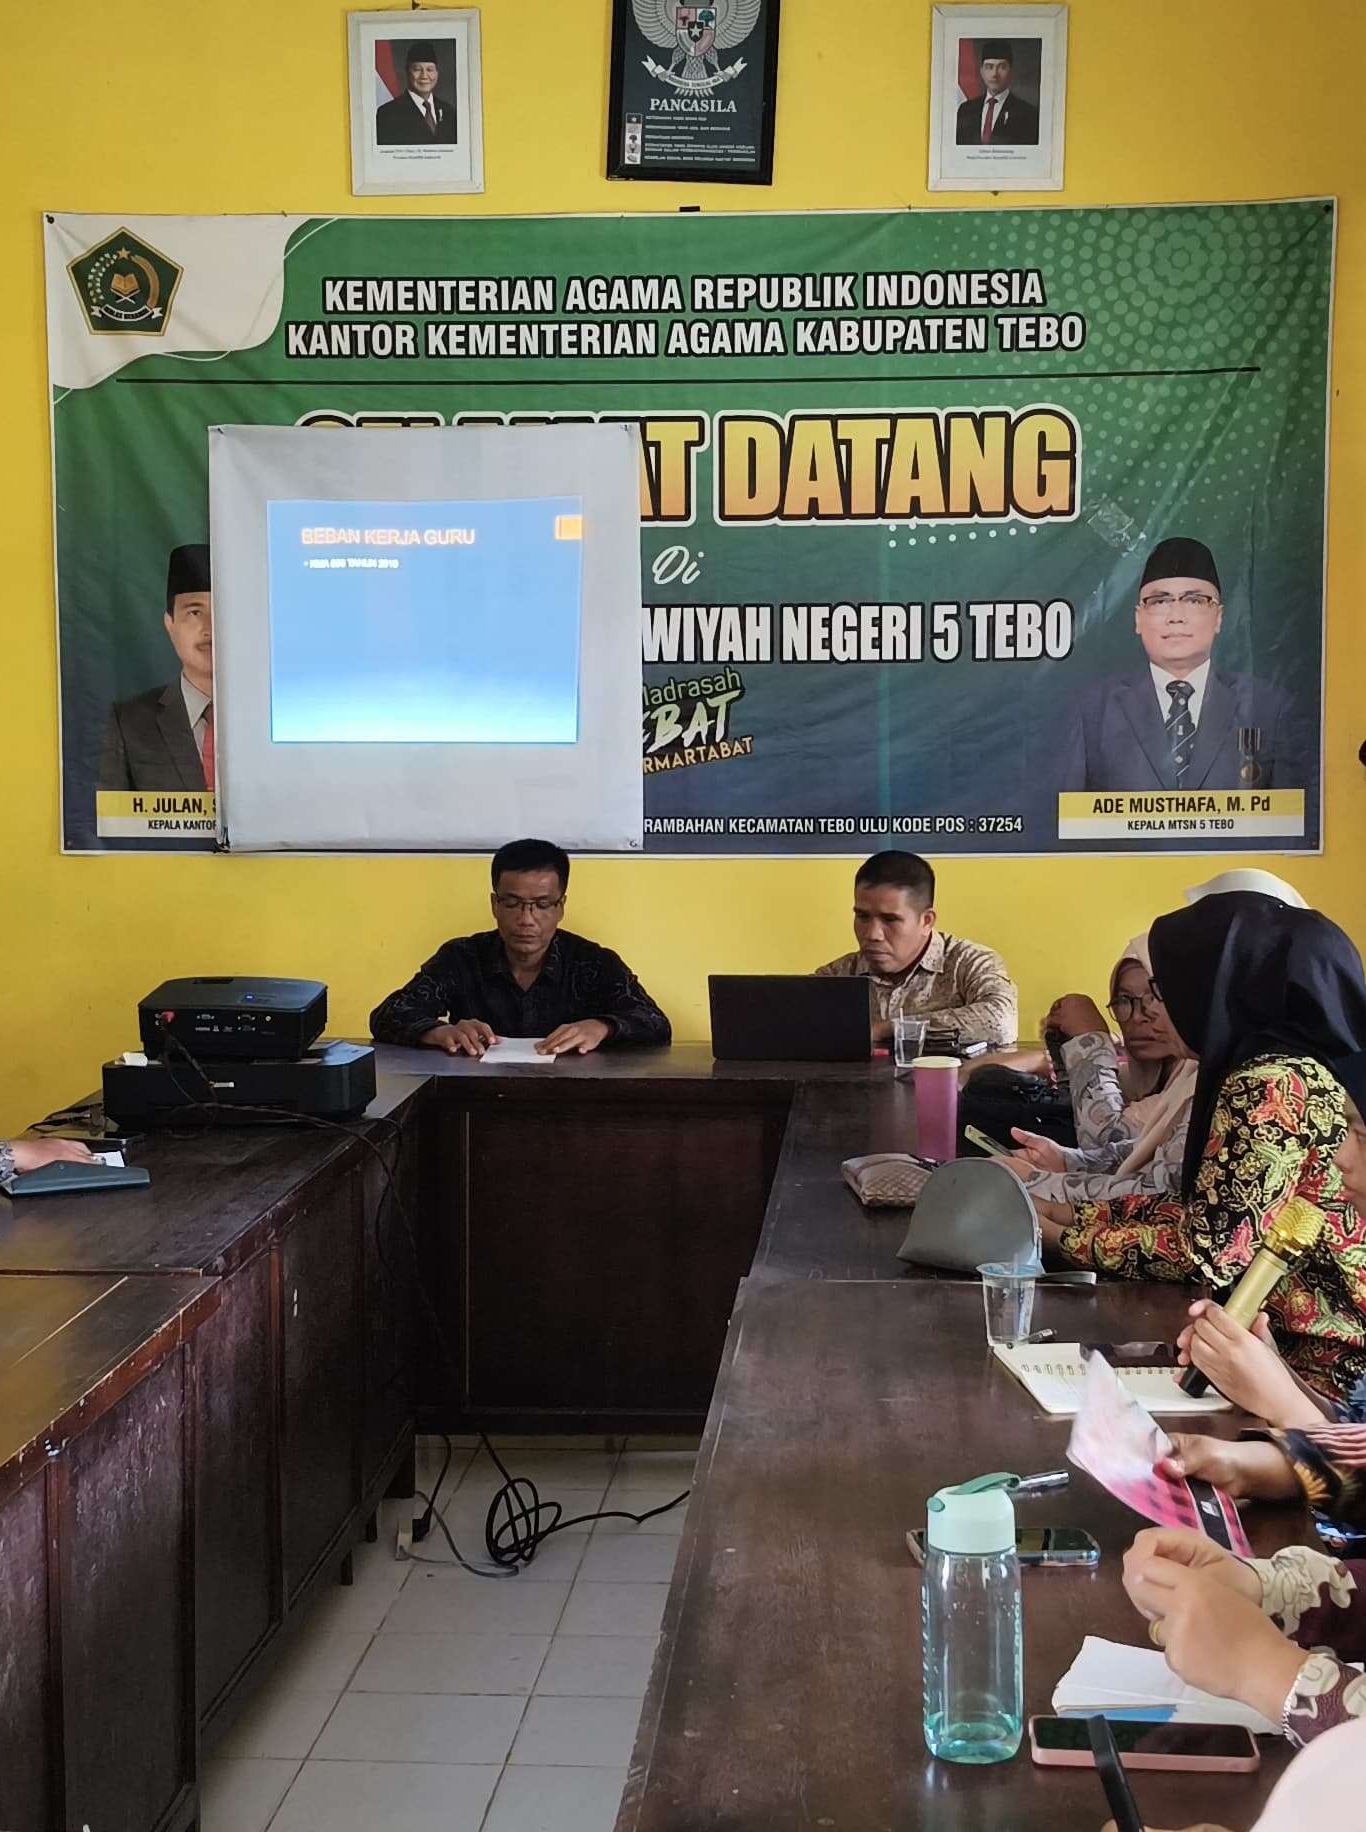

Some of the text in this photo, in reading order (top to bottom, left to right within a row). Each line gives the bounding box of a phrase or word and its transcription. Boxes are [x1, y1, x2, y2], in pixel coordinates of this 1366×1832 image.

[650, 98, 737, 113] PANCASILA
[324, 272, 1045, 313] KEMENTERIAN AGAMA REPUBLIK INDONESIA
[287, 314, 1084, 356] KANTOR KEMENTERIAN AGAMA KABUPATEN TEBO
[722, 413, 1073, 517] DATANG
[302, 527, 475, 546] BEBAN KERJA GURU
[651, 544, 705, 585] Di
[642, 602, 1072, 662] WIYAH NEGERI 5 TEBO
[133, 797, 207, 816] H. JULAN,
[1092, 796, 1271, 815] ADE MUSTHAFA, M. Pd
[148, 820, 180, 830] KEPALA
[644, 818, 724, 834] RAMBAHAN
[729, 818, 814, 834] KECAMATAN
[818, 818, 855, 833] TEBO
[860, 818, 888, 833] ULU
[892, 817, 932, 832] KODE
[936, 817, 966, 832] POS
[978, 816, 1023, 832] 37254
[1127, 818, 1235, 831] KEPALA MTSN 5 TEBO
